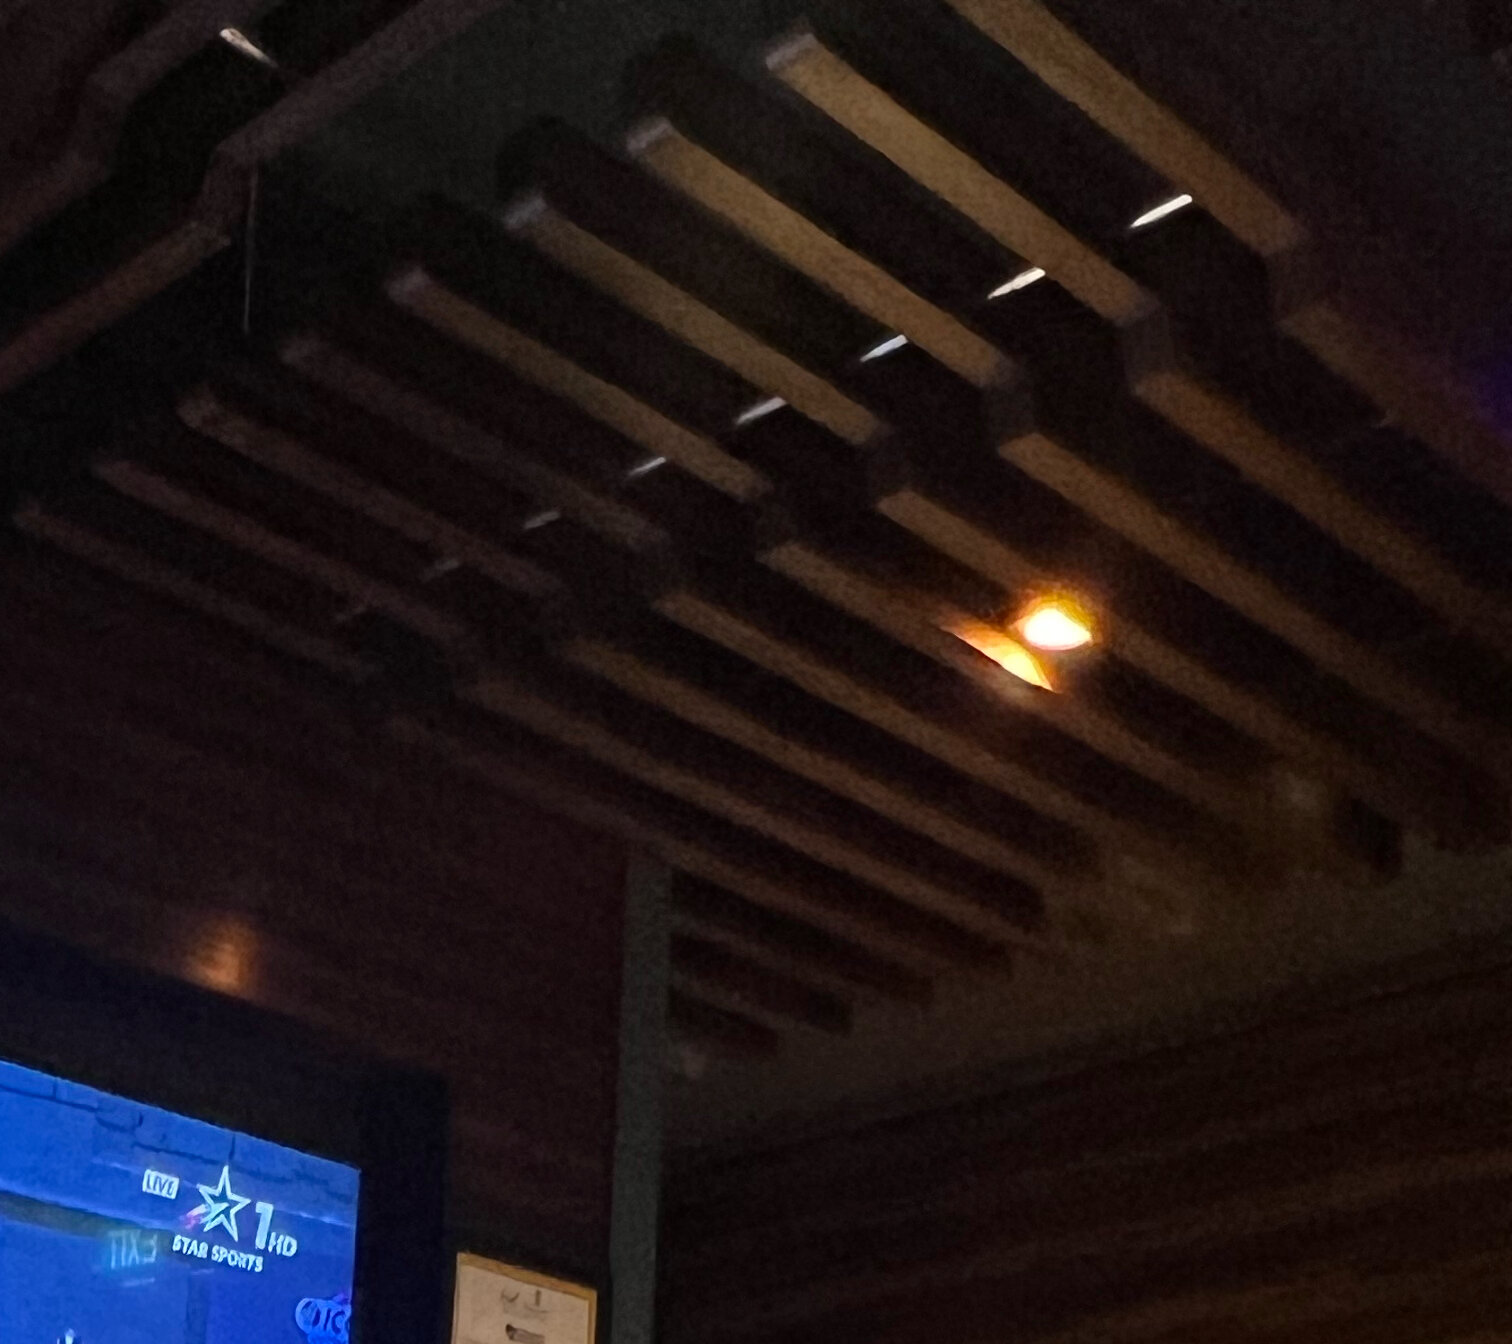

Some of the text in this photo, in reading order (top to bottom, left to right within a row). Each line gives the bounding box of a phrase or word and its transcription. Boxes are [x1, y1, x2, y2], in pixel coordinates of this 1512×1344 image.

[172, 1234, 263, 1273] STAR SPORTS
[268, 1232, 298, 1257] HD
